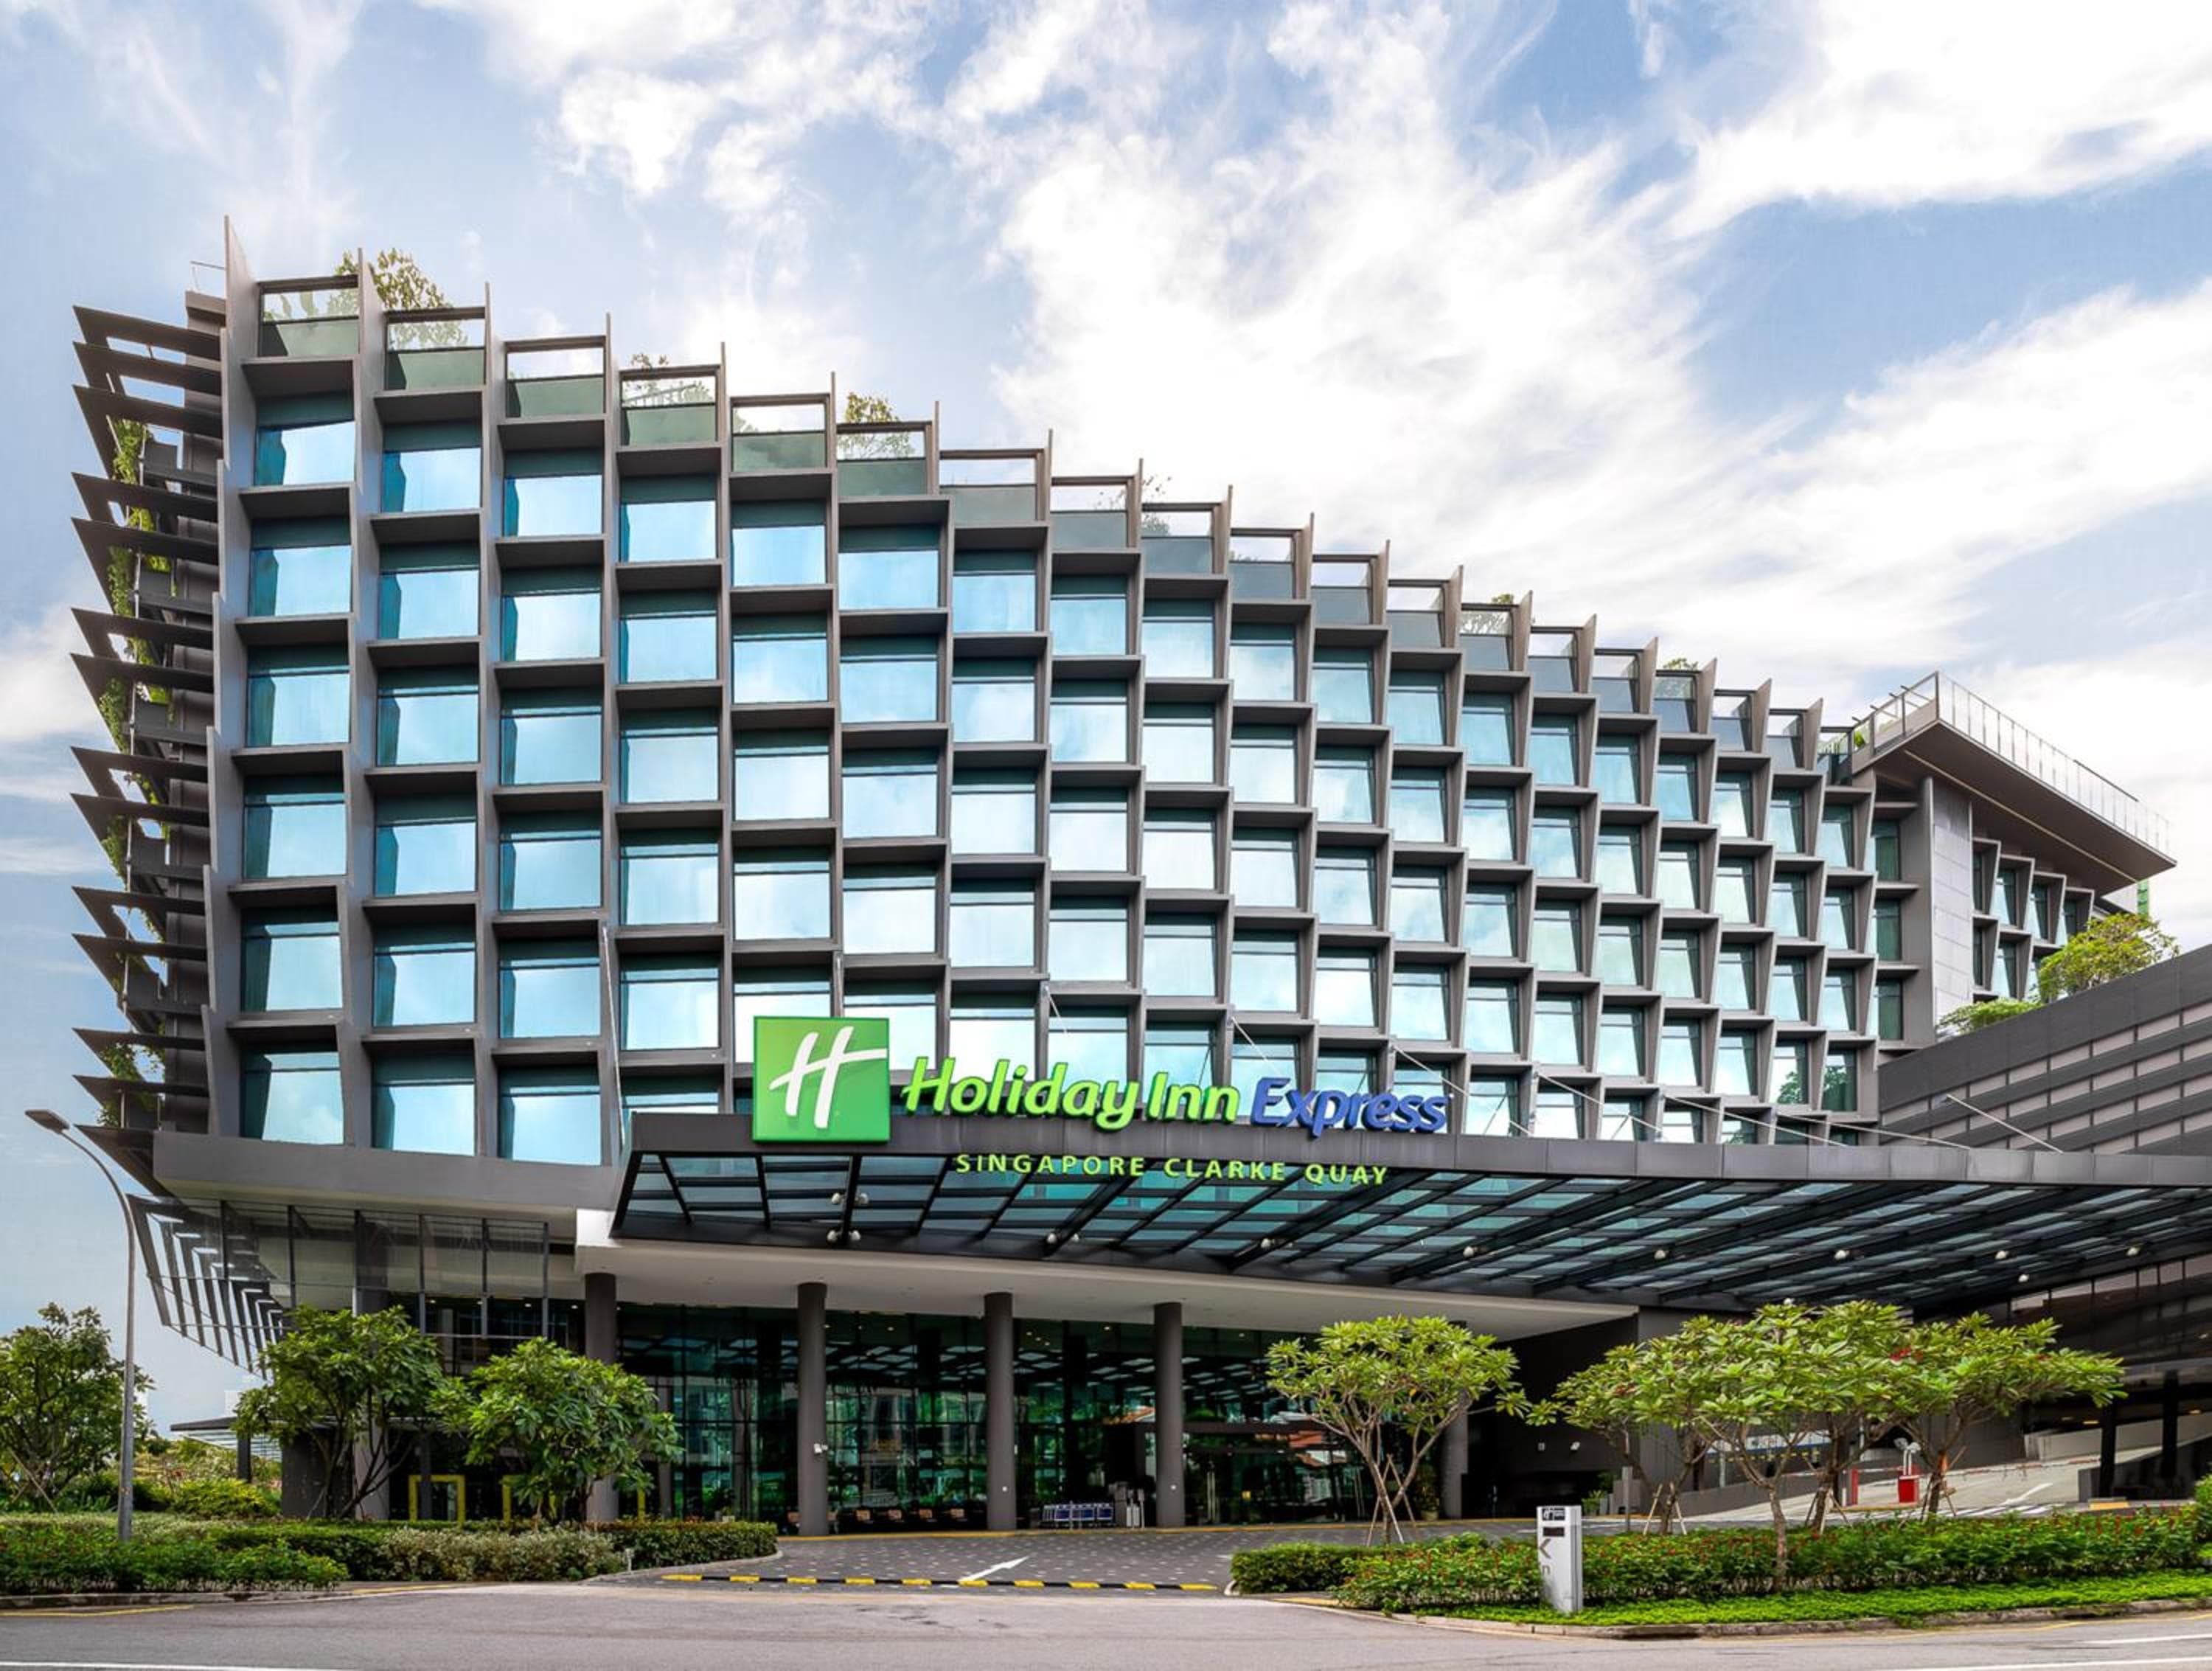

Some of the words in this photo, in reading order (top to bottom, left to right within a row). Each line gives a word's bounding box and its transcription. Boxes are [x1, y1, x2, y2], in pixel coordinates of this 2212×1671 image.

[769, 1026, 888, 1128] H
[902, 1056, 1140, 1131] Holiday
[1145, 1071, 1240, 1123] Inn
[1251, 1077, 1449, 1139] Express
[956, 1153, 1145, 1178] SINGAPORE
[1164, 1156, 1287, 1181] CLARKE
[1304, 1163, 1388, 1186] QUAY
